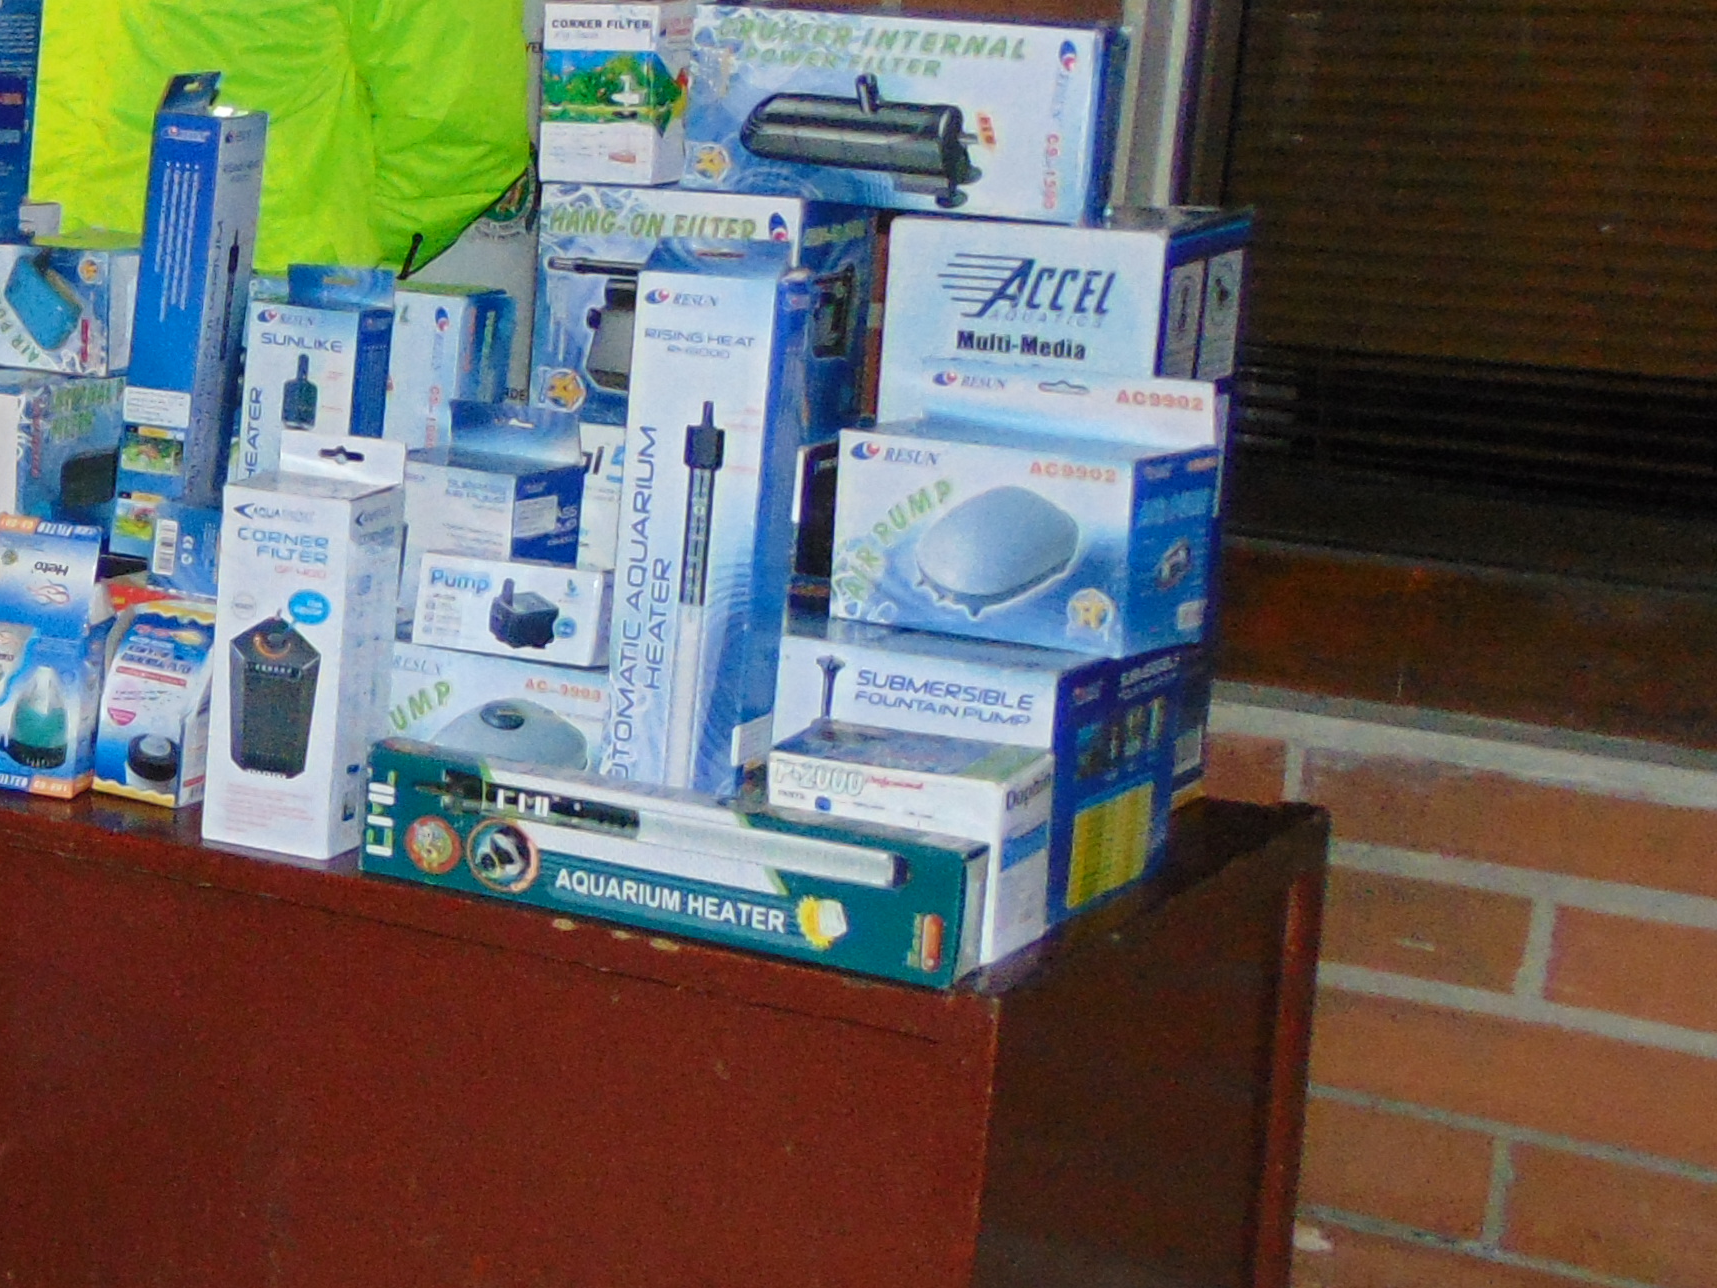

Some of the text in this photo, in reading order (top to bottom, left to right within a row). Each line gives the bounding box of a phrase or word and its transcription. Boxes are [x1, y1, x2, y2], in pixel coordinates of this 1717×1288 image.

[551, 18, 650, 30] CORNER FILTER
[862, 26, 1026, 60] INTERNAL
[747, 47, 942, 78] POWER FILTER
[549, 209, 757, 240] HANG-ON FILTER
[955, 257, 1116, 318] ACCEL
[260, 331, 343, 353] SUNLIKE
[644, 327, 755, 348] RISING HEAT
[956, 330, 1087, 360] Multi-Media
[1117, 389, 1204, 412] AC9902
[884, 448, 942, 466] RESUN
[872, 478, 954, 549] PUMP
[237, 526, 329, 550] CORNER
[256, 546, 328, 566] FILTER
[430, 568, 490, 593] Pump
[611, 425, 658, 781] UTOMATIC AQUARIUM
[643, 557, 672, 690] HEATER
[856, 669, 1035, 711] SUBMERSIBLE
[389, 681, 451, 731] UMP
[854, 690, 1032, 726] FOUNTAIN PUMP
[554, 867, 786, 934] AQUARIUM HEATER
